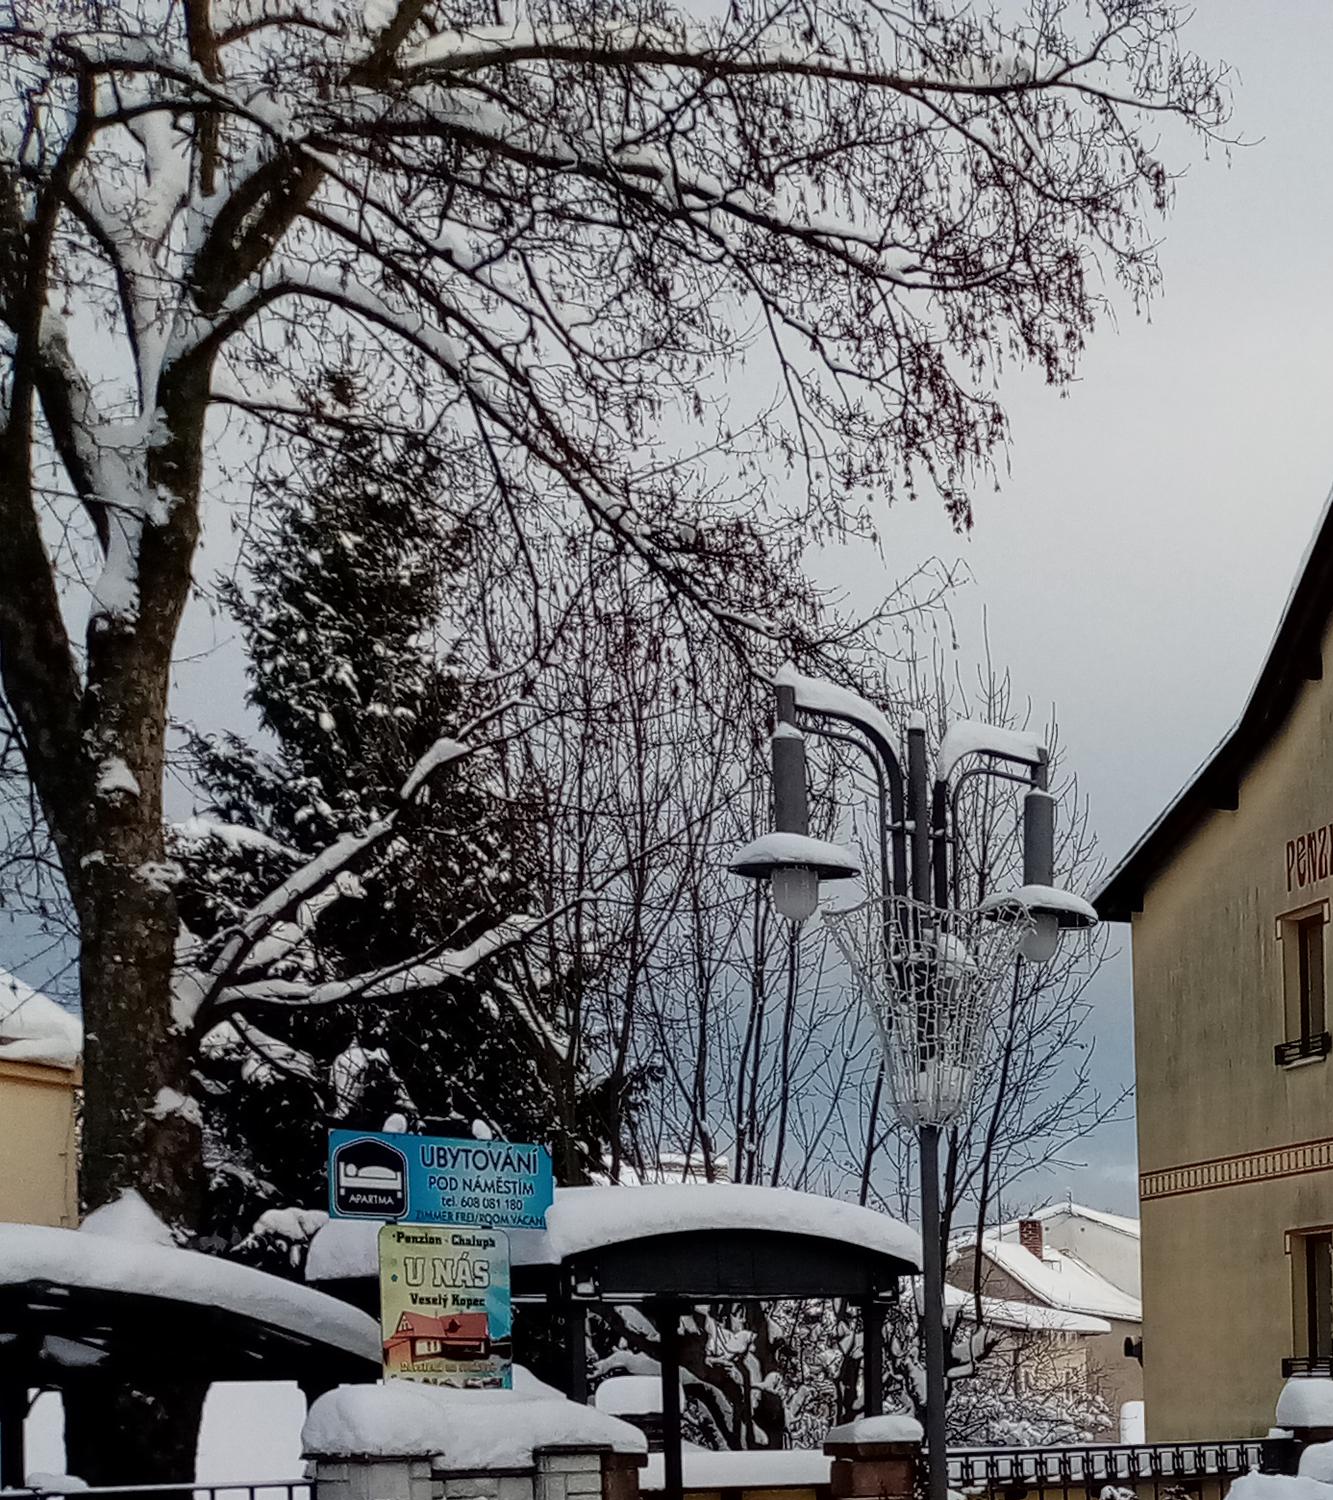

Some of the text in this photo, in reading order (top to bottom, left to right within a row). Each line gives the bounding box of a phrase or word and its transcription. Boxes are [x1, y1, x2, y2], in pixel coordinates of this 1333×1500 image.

[420, 1145, 538, 1174] UBYTOVÁNÍ
[428, 1175, 534, 1196] POD NÁMĚSTÍM
[348, 1194, 395, 1205] APARTMA
[441, 1195, 458, 1207] tel.
[460, 1196, 480, 1208] 608
[505, 1199, 523, 1211] 180
[396, 1231, 442, 1245] Penzion
[403, 1251, 490, 1288] U NÁS
[410, 1292, 486, 1309] Veselý Kopec
